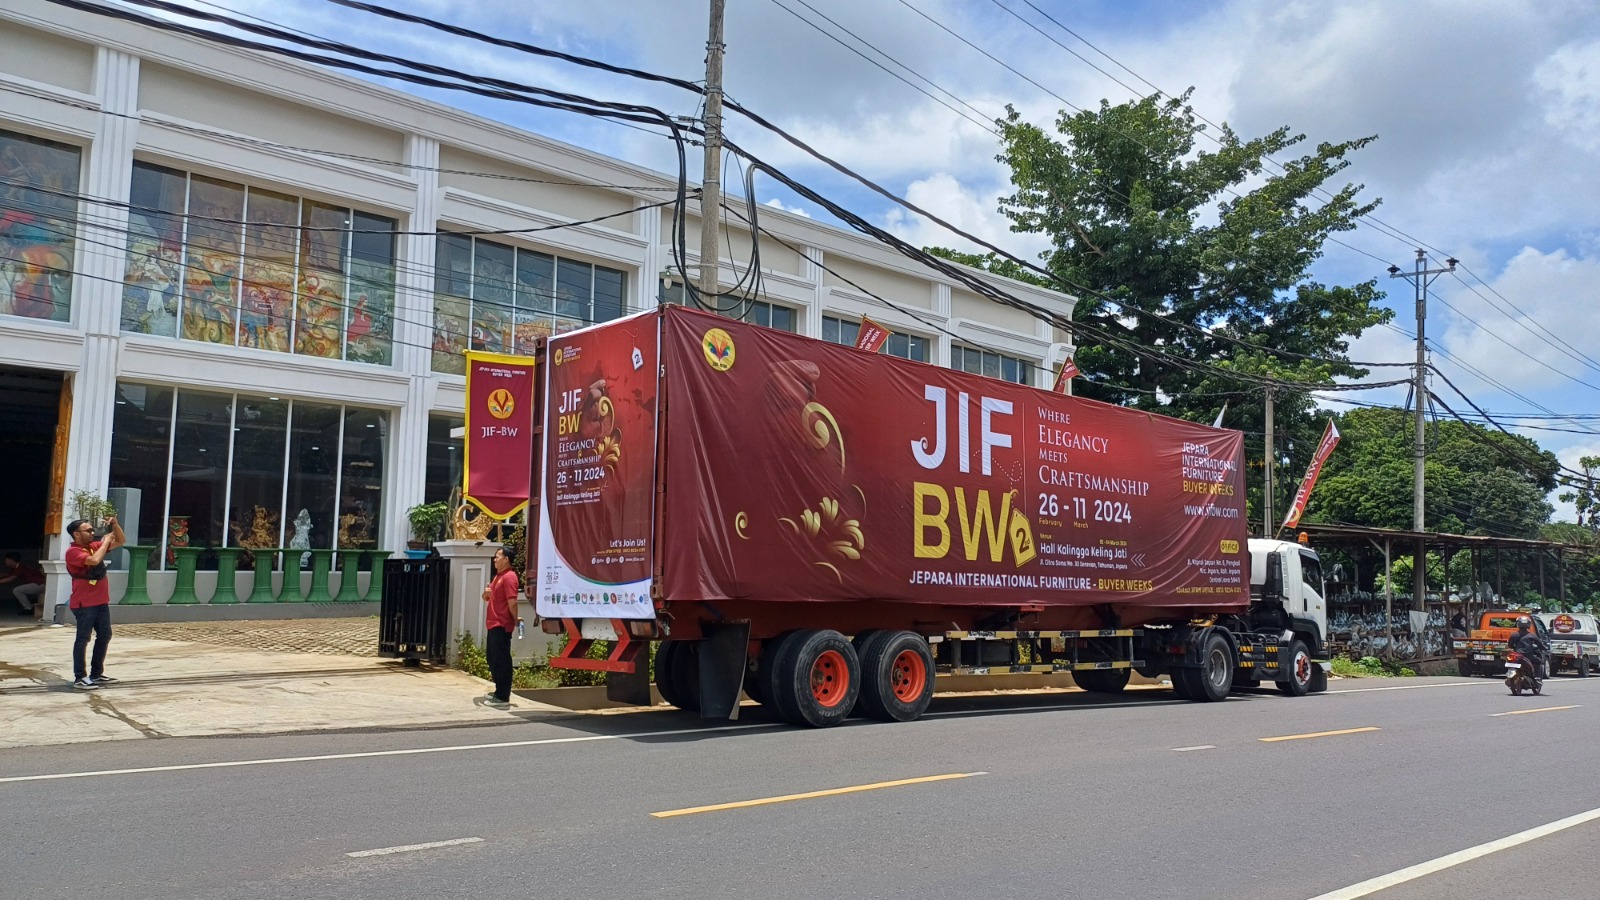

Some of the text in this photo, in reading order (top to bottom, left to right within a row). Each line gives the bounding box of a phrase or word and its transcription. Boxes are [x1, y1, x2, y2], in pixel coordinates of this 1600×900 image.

[558, 388, 582, 414] JIF
[559, 412, 582, 435] BW
[1038, 406, 1070, 424] WHERE
[482, 426, 518, 438] JIF-BW
[911, 384, 1014, 476] JIF
[1038, 424, 1108, 454] ELEGANCY
[559, 438, 596, 453] ELEGANCY
[1182, 442, 1209, 456] JEPARA
[558, 454, 602, 468] CRAFTSMANSHIP
[1038, 448, 1068, 464] MEETS
[1182, 454, 1237, 472] INTERNATIONAL
[556, 471, 566, 484] 26
[574, 470, 582, 482] 11
[584, 466, 605, 480] 2024
[1038, 465, 1149, 496] CRAFTSMANSHIP
[1182, 466, 1224, 482] FURNITURE
[1183, 480, 1234, 496] BUYER WEEKS
[1038, 493, 1058, 516] 26
[1072, 497, 1086, 520] 11
[1094, 500, 1132, 524] 2024
[914, 481, 1019, 562] BW
[1038, 518, 1088, 528] February March
[610, 538, 646, 548] Let's Join Us!
[1040, 542, 1128, 560] Hall Kalingga Keling Jati
[909, 570, 952, 586] JEPARA
[954, 572, 1038, 588] INTERNATIONAL
[1040, 576, 1092, 590] FURNITURE
[1098, 578, 1125, 591] BUYER
[1126, 580, 1153, 592] WEEKS
